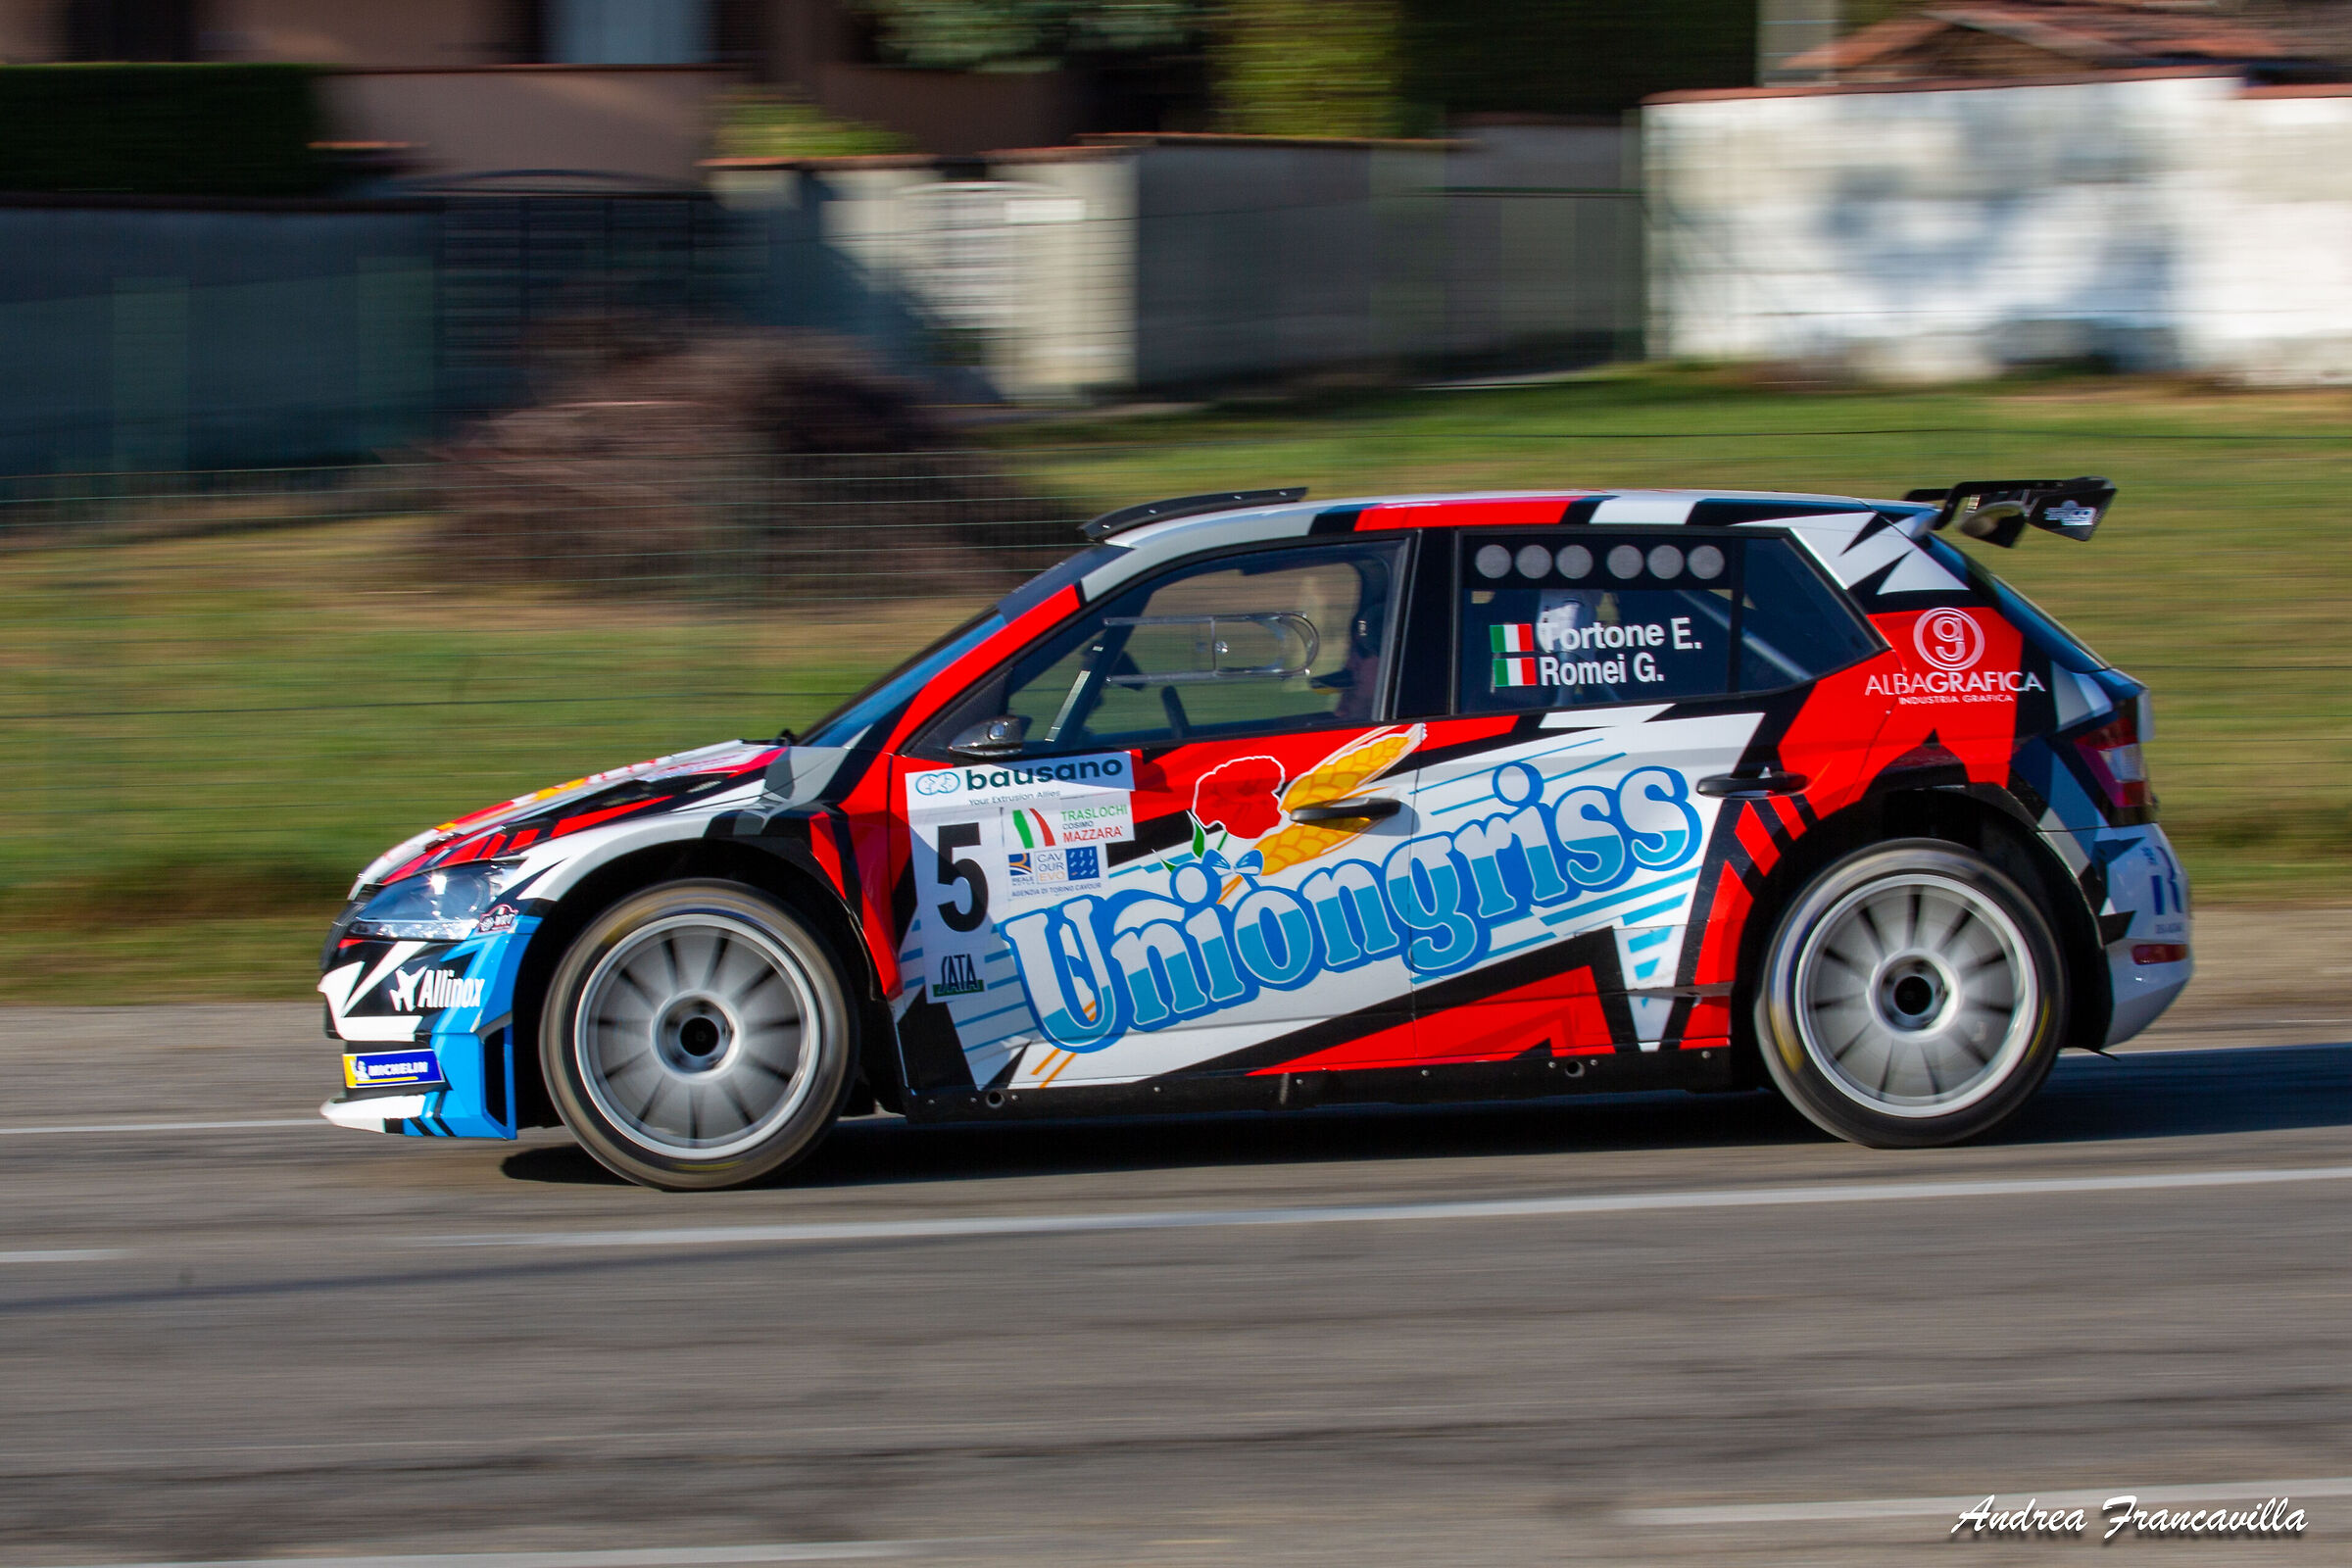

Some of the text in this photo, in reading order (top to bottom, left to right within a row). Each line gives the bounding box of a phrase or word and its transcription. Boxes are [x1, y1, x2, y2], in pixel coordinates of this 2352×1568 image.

[1671, 616, 1703, 650] E.
[1539, 652, 1664, 686] Romei G.
[1864, 671, 2046, 696] ALBAGRAFICA
[1898, 694, 2014, 705] INDUSTRIA GRAFICA
[966, 758, 1123, 791] bausano
[968, 797, 989, 806] Your
[992, 793, 1034, 804] Extrusion
[1061, 805, 1128, 822] TRASLOCHI
[1062, 820, 1094, 830] COSIMO
[1037, 852, 1063, 862] CAV
[1039, 861, 1065, 872] OUR
[937, 822, 989, 932] 5
[1040, 871, 1065, 882] EVO
[999, 760, 1703, 1054] Uniongriss
[416, 969, 486, 1008] Allinox
[368, 1061, 428, 1076] MICHELIN
